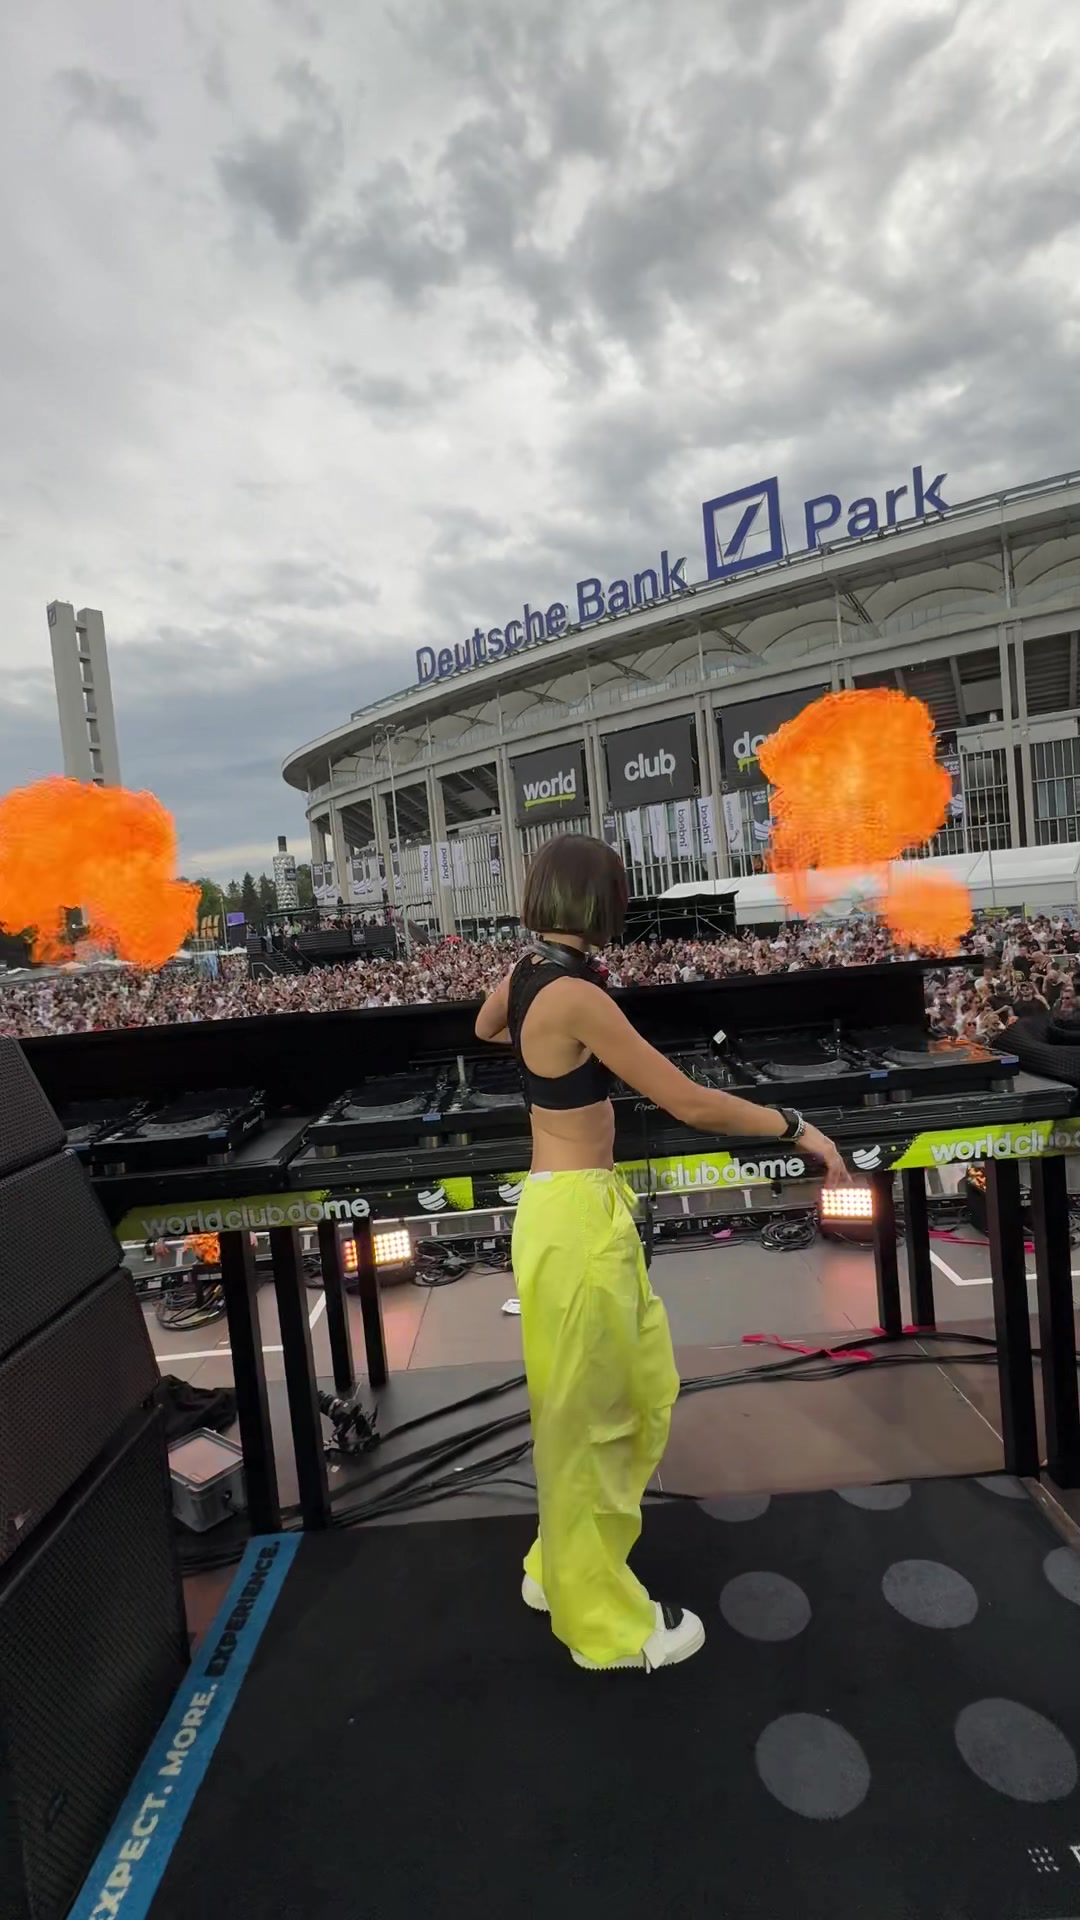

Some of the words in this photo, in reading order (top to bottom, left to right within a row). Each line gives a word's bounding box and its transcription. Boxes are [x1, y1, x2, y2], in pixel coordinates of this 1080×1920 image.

[416, 602, 570, 686] Deutsche
[575, 550, 688, 624] Bank
[804, 465, 951, 550] Park
[523, 768, 576, 800] world
[624, 749, 676, 781] club
[733, 731, 768, 759] do
[89, 1784, 173, 1920] XPECT.
[158, 1683, 218, 1777] MORE.
[204, 1539, 281, 1678] EXPERIENCE.
